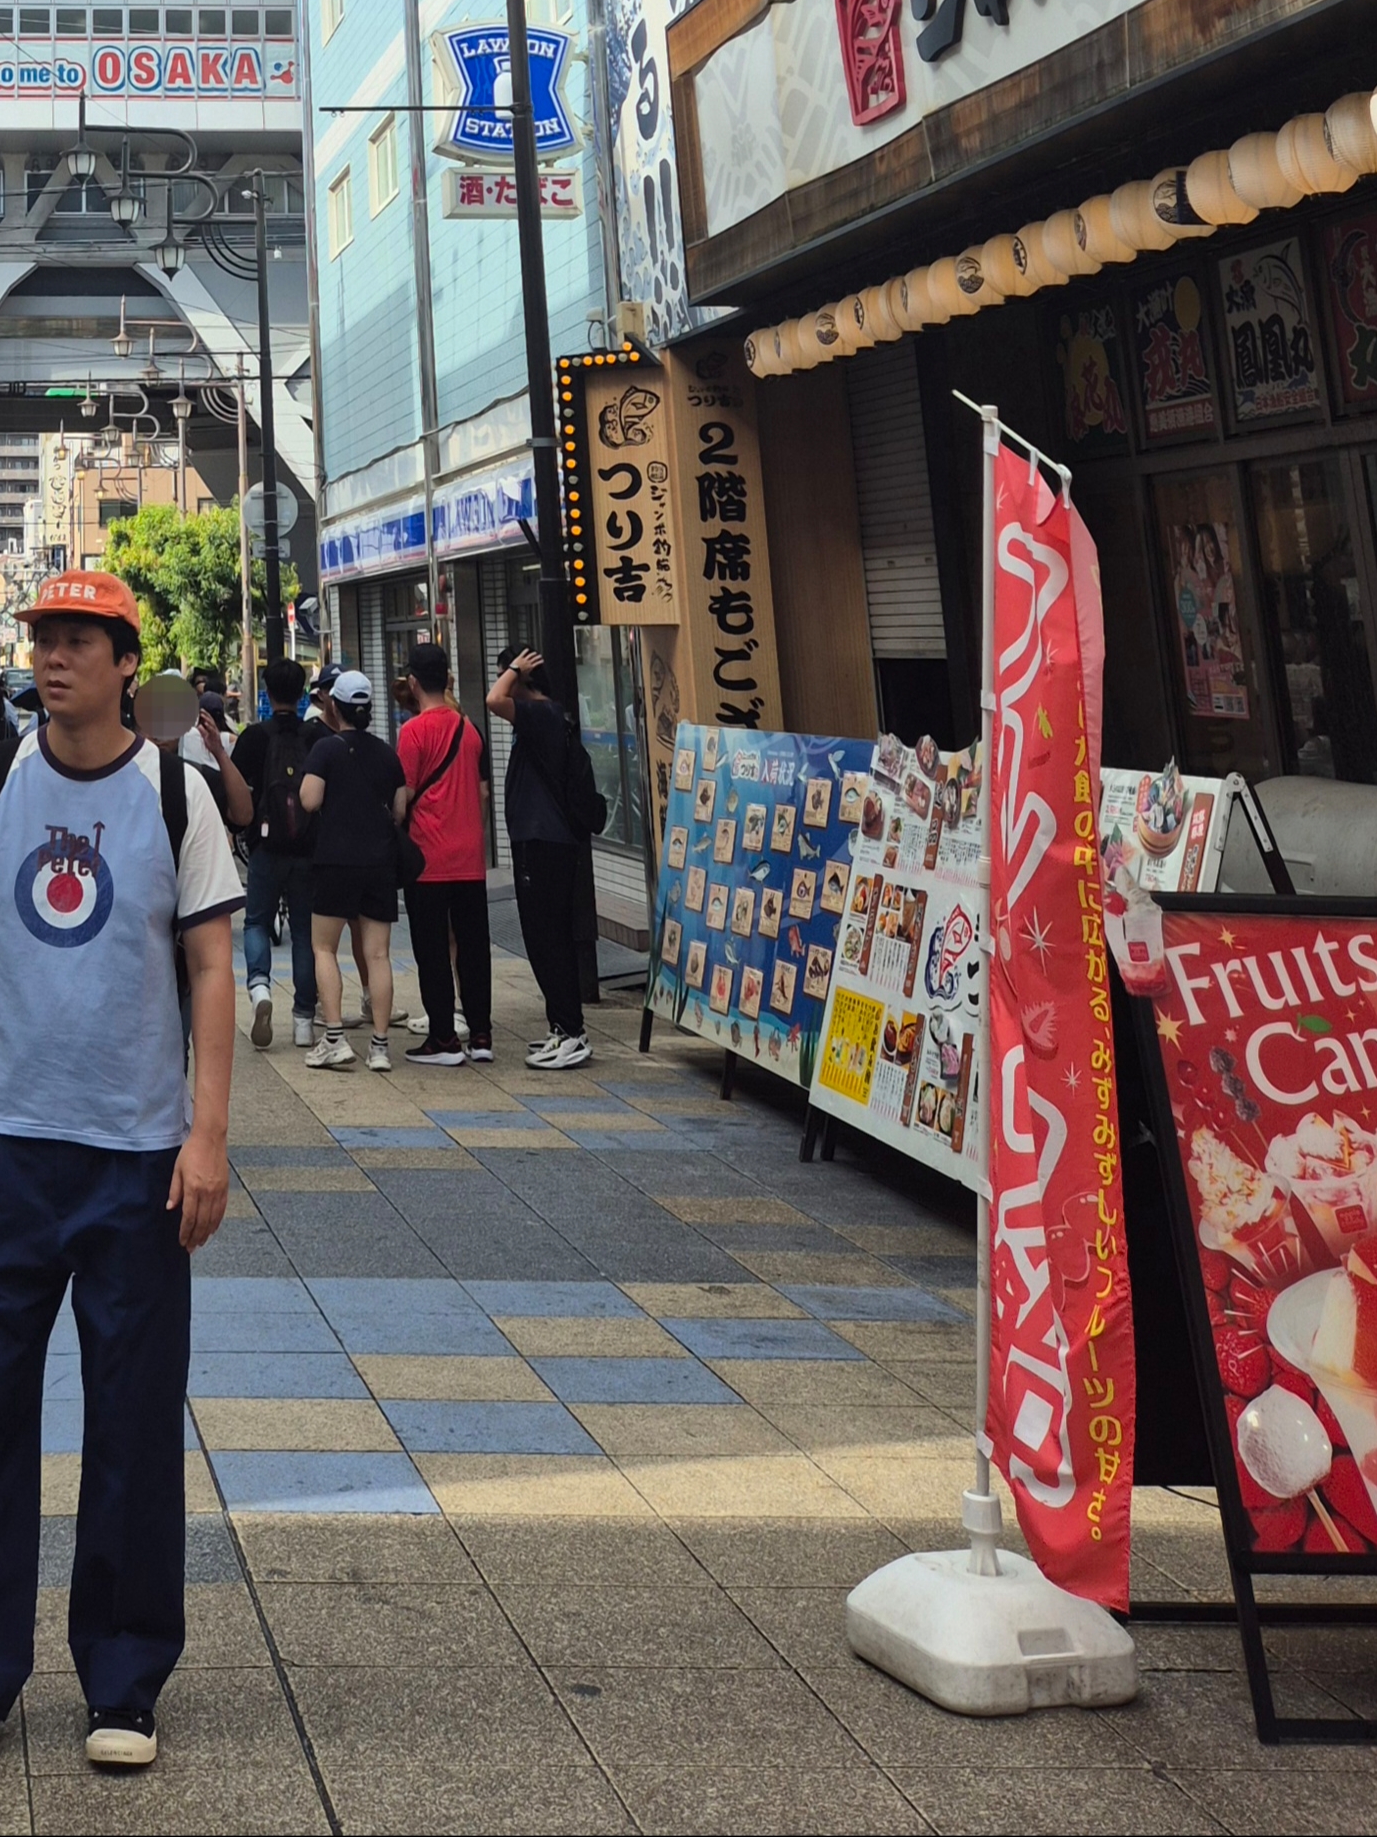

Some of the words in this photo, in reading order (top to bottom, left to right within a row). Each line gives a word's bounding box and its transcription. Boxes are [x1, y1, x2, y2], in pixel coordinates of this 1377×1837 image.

[459, 37, 558, 60] LAWON
[54, 59, 83, 87] to
[94, 48, 263, 90] OSAKA
[598, 462, 651, 604] つり吉
[39, 581, 97, 605] PETER
[44, 823, 90, 855] The
[37, 847, 102, 879] Peter
[1165, 929, 1377, 1027] Fruits
